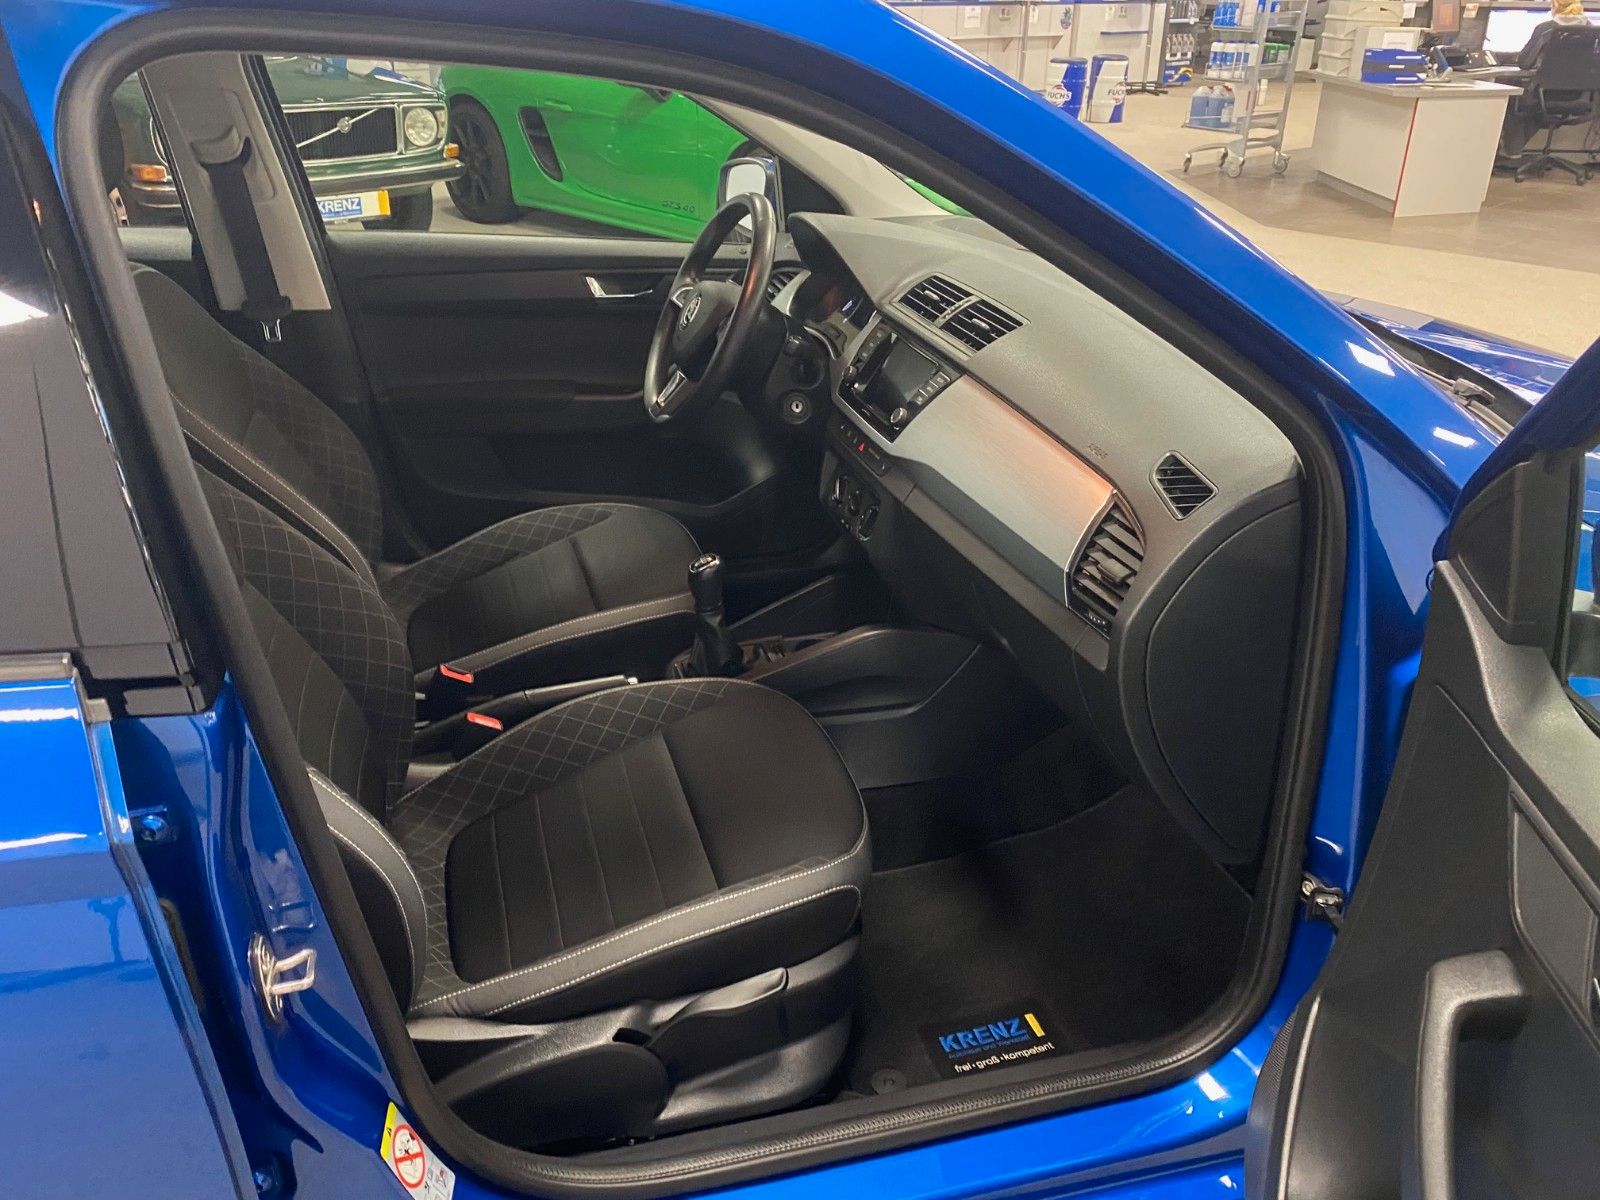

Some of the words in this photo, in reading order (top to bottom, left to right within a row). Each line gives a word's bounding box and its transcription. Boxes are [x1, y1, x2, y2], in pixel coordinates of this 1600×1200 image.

[317, 197, 361, 213] KRENZ
[939, 1018, 1026, 1053] KRENZ
[954, 1062, 973, 1074] frei
[976, 1055, 1001, 1070] groß
[1002, 1041, 1056, 1061] kompetent
